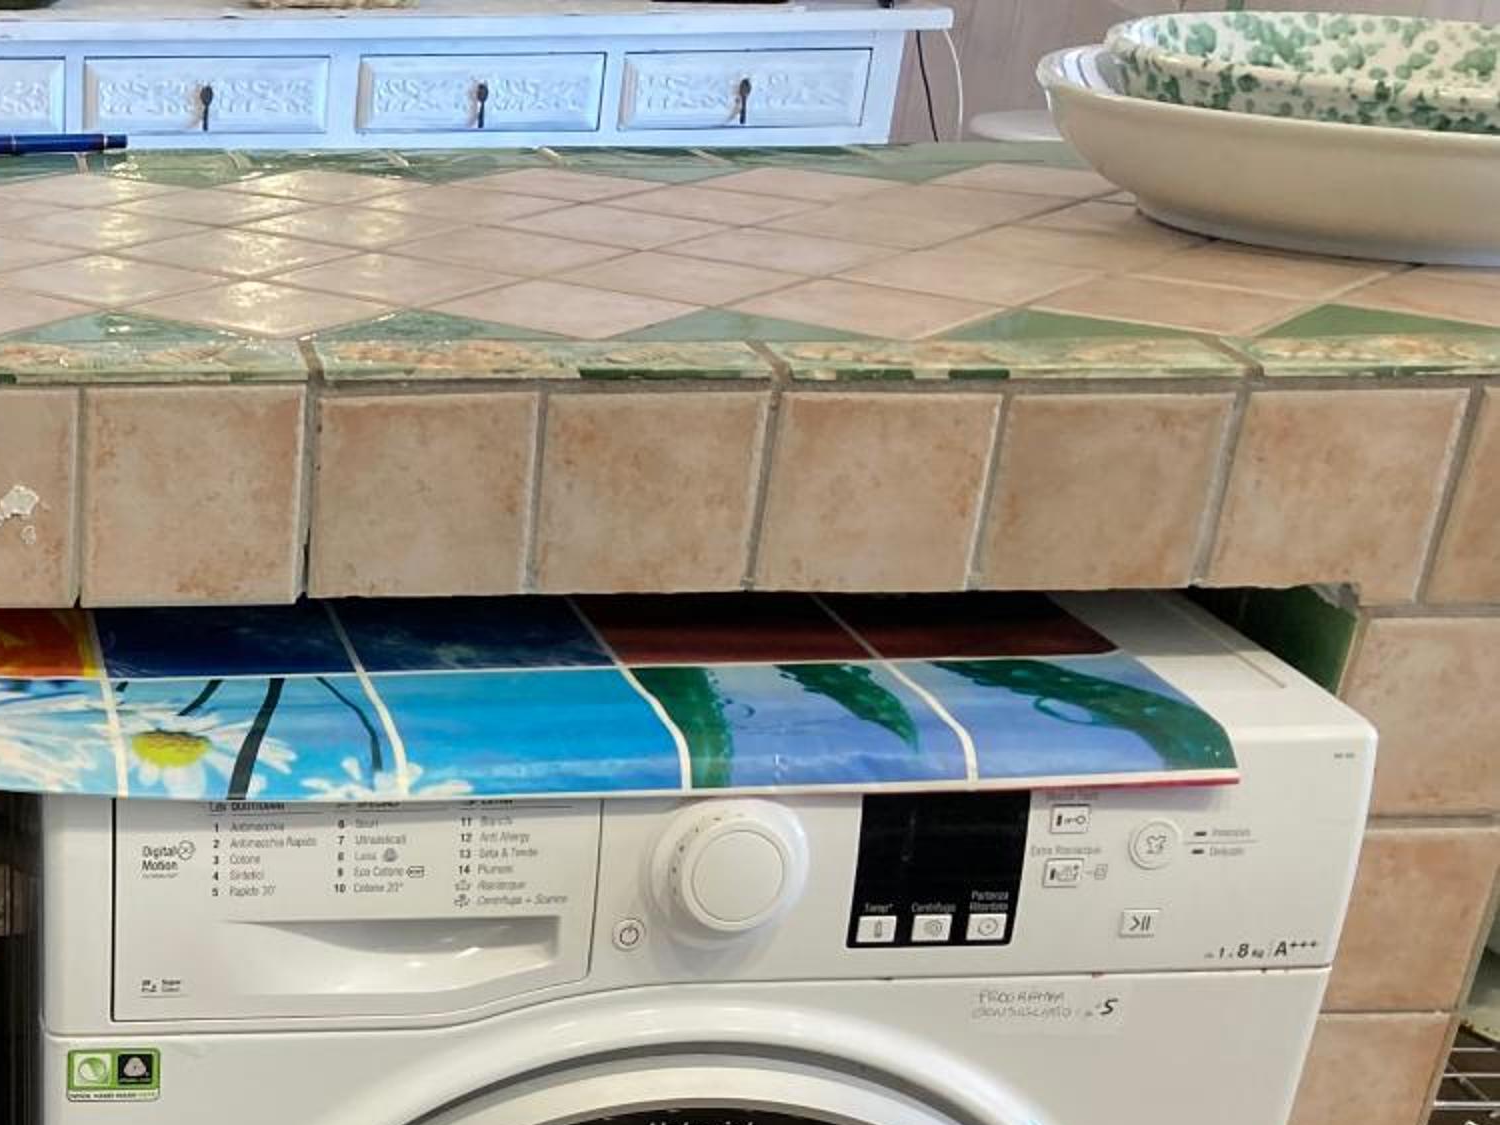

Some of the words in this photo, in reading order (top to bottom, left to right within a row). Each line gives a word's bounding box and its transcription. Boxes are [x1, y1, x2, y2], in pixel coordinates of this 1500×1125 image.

[338, 836, 344, 845] 7
[461, 833, 472, 842] 12
[213, 839, 220, 848] 2
[142, 845, 179, 860] Digital
[142, 860, 178, 871] Motion
[458, 865, 470, 875] 14
[212, 872, 219, 881] 4
[1099, 997, 1119, 1016] 5
